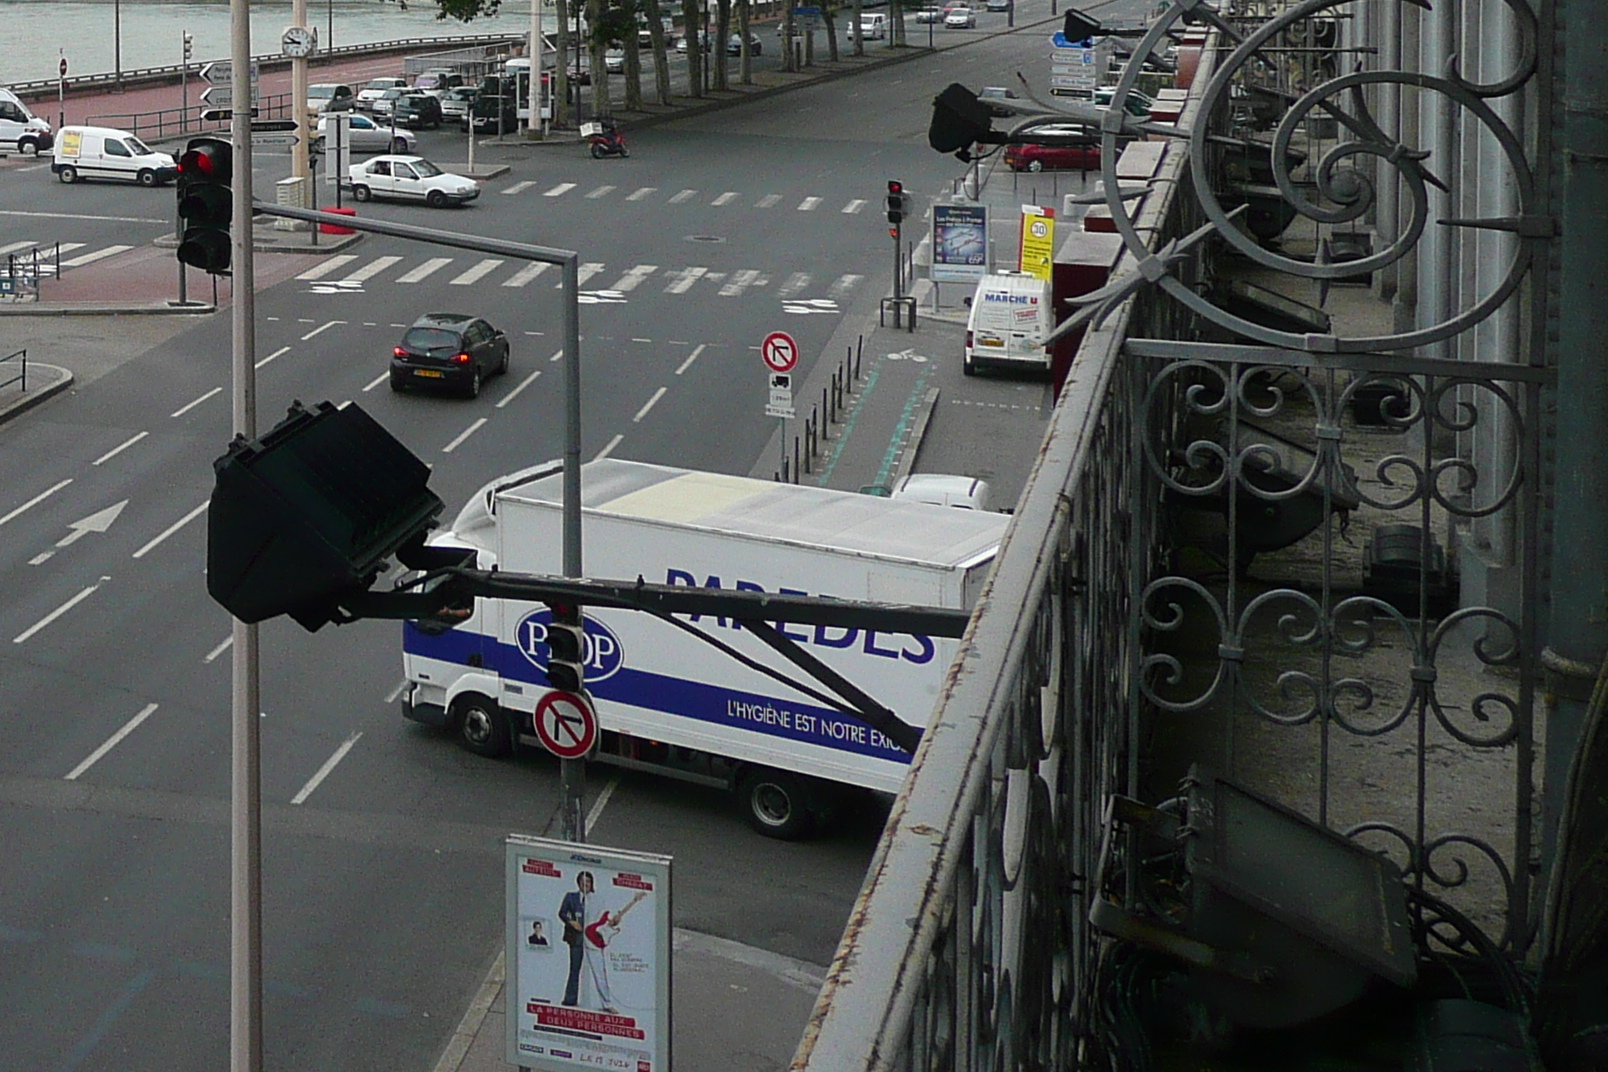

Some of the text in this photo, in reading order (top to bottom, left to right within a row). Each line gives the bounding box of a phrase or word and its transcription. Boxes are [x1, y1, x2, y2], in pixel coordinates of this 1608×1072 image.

[667, 569, 934, 664] PAEDES
[526, 621, 615, 669] PP
[727, 700, 791, 728] L'HYGIÈNE
[795, 713, 817, 732] EST
[821, 719, 866, 744] NOTRE
[530, 1005, 625, 1025] LA PERSONNE AUX
[546, 1016, 573, 1027] DEUX
[577, 1021, 640, 1038] PERSONNES
